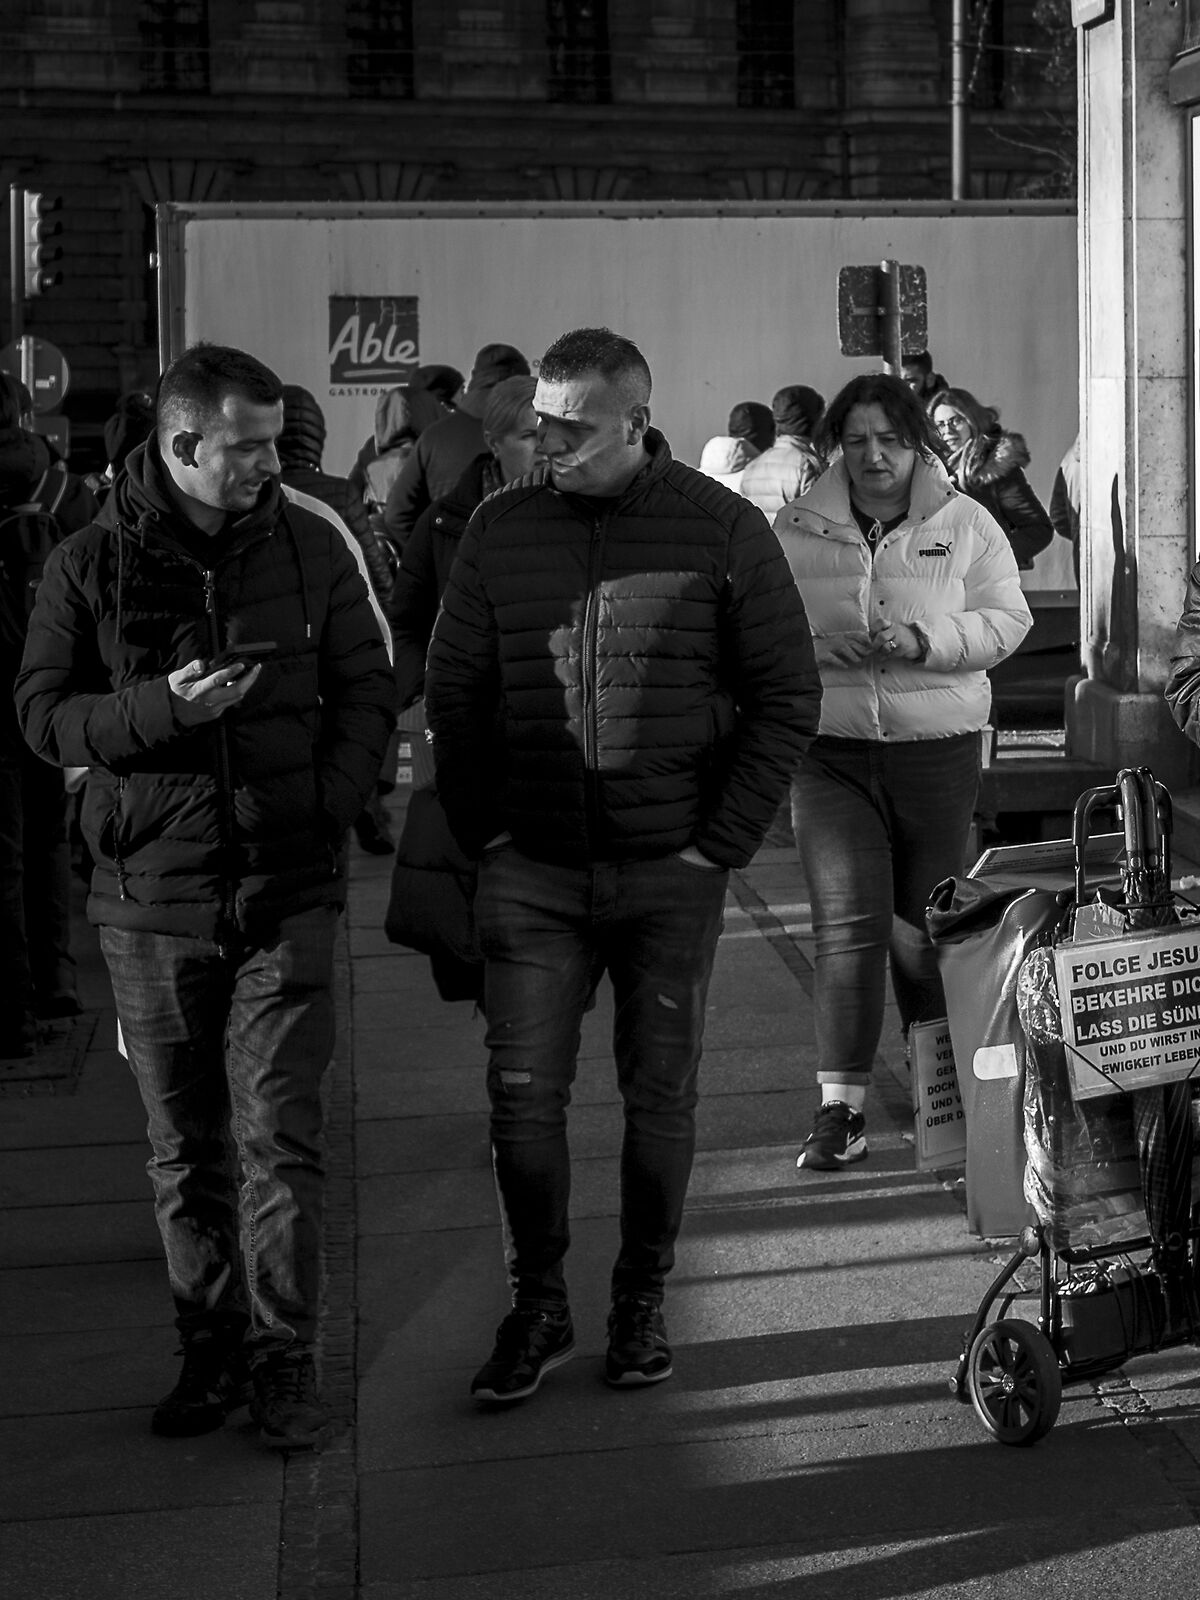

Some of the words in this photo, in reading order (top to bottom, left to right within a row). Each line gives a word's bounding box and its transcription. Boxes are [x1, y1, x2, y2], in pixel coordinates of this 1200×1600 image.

[328, 314, 420, 365] Able
[918, 548, 947, 557] PUMA
[1071, 954, 1142, 984] FOLGE
[1072, 981, 1168, 1015] BEKEHRE
[1076, 1018, 1124, 1042] LASS
[1128, 1012, 1158, 1033] DIE
[1099, 1038, 1127, 1058] UND
[1130, 1037, 1147, 1052] DU
[1149, 1031, 1187, 1049] WIRST
[1101, 1054, 1162, 1076] EWIGKEIT
[927, 1080, 955, 1096] DOCH
[931, 1097, 953, 1111] UND
[926, 1111, 954, 1128] ÜBER
